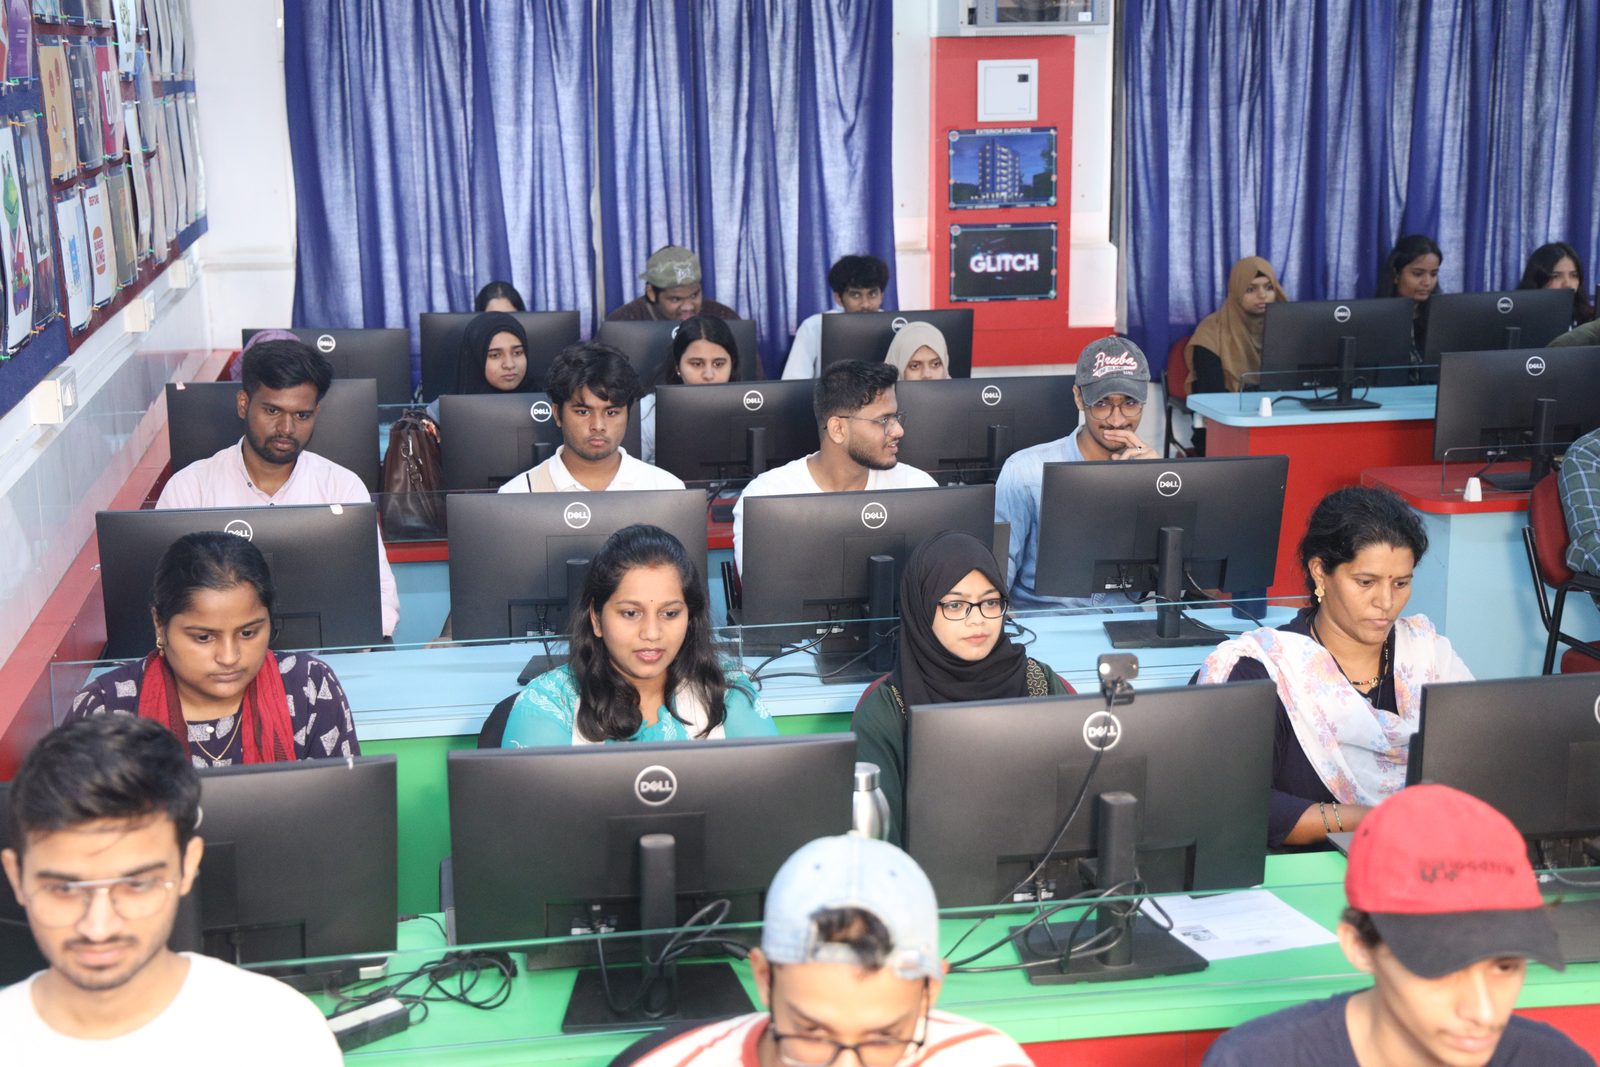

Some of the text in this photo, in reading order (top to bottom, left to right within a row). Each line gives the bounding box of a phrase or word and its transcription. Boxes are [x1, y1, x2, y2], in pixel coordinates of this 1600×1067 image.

[969, 253, 1039, 273] GLITCH
[1160, 480, 1179, 488] DELL
[568, 511, 588, 519] DELL
[640, 780, 673, 792] DELL
